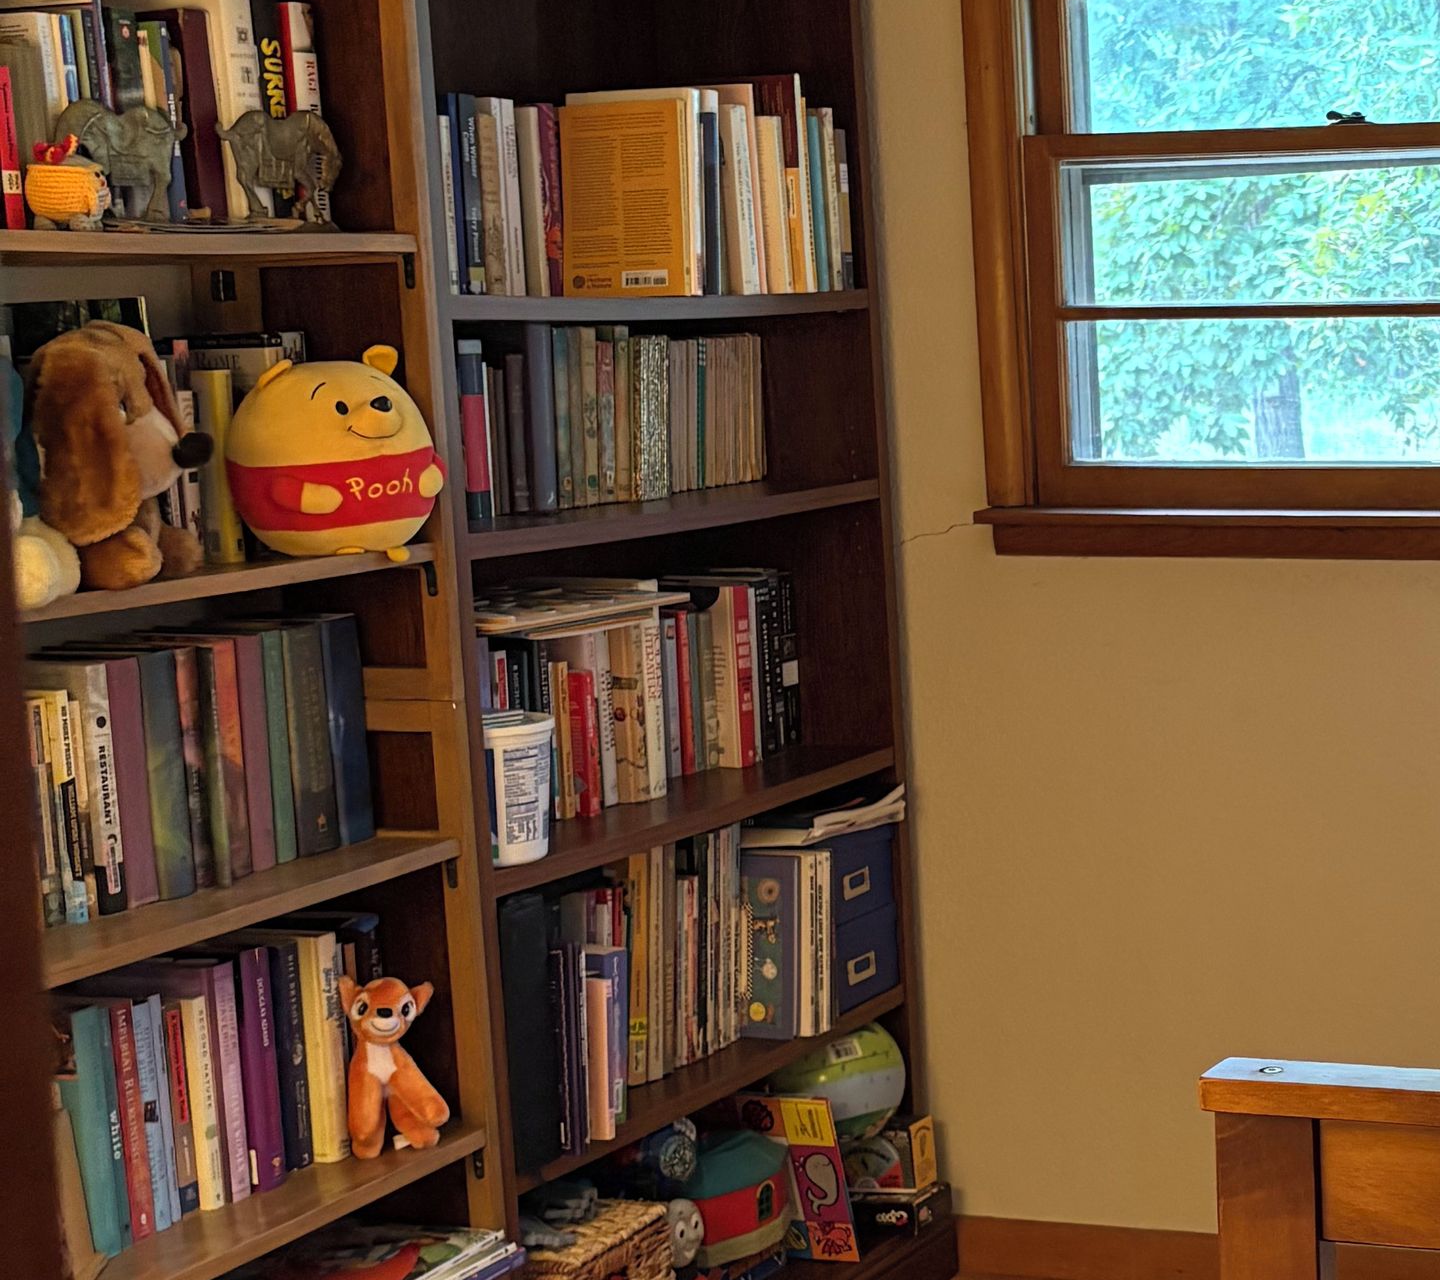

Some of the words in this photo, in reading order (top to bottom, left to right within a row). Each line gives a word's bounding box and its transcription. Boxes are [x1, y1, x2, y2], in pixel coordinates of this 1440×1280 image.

[306, 61, 317, 95] RAGE
[467, 116, 476, 144] When
[469, 145, 478, 178] Winter
[346, 468, 413, 501] Pooh
[99, 745, 111, 826] RESTAURANT
[256, 977, 267, 1017] DOUGLAS
[116, 1009, 133, 1072] IMPERIAL
[198, 1008, 208, 1057] SECOND
[204, 1063, 213, 1111] NATURE
[123, 1078, 139, 1165] RECKONING
